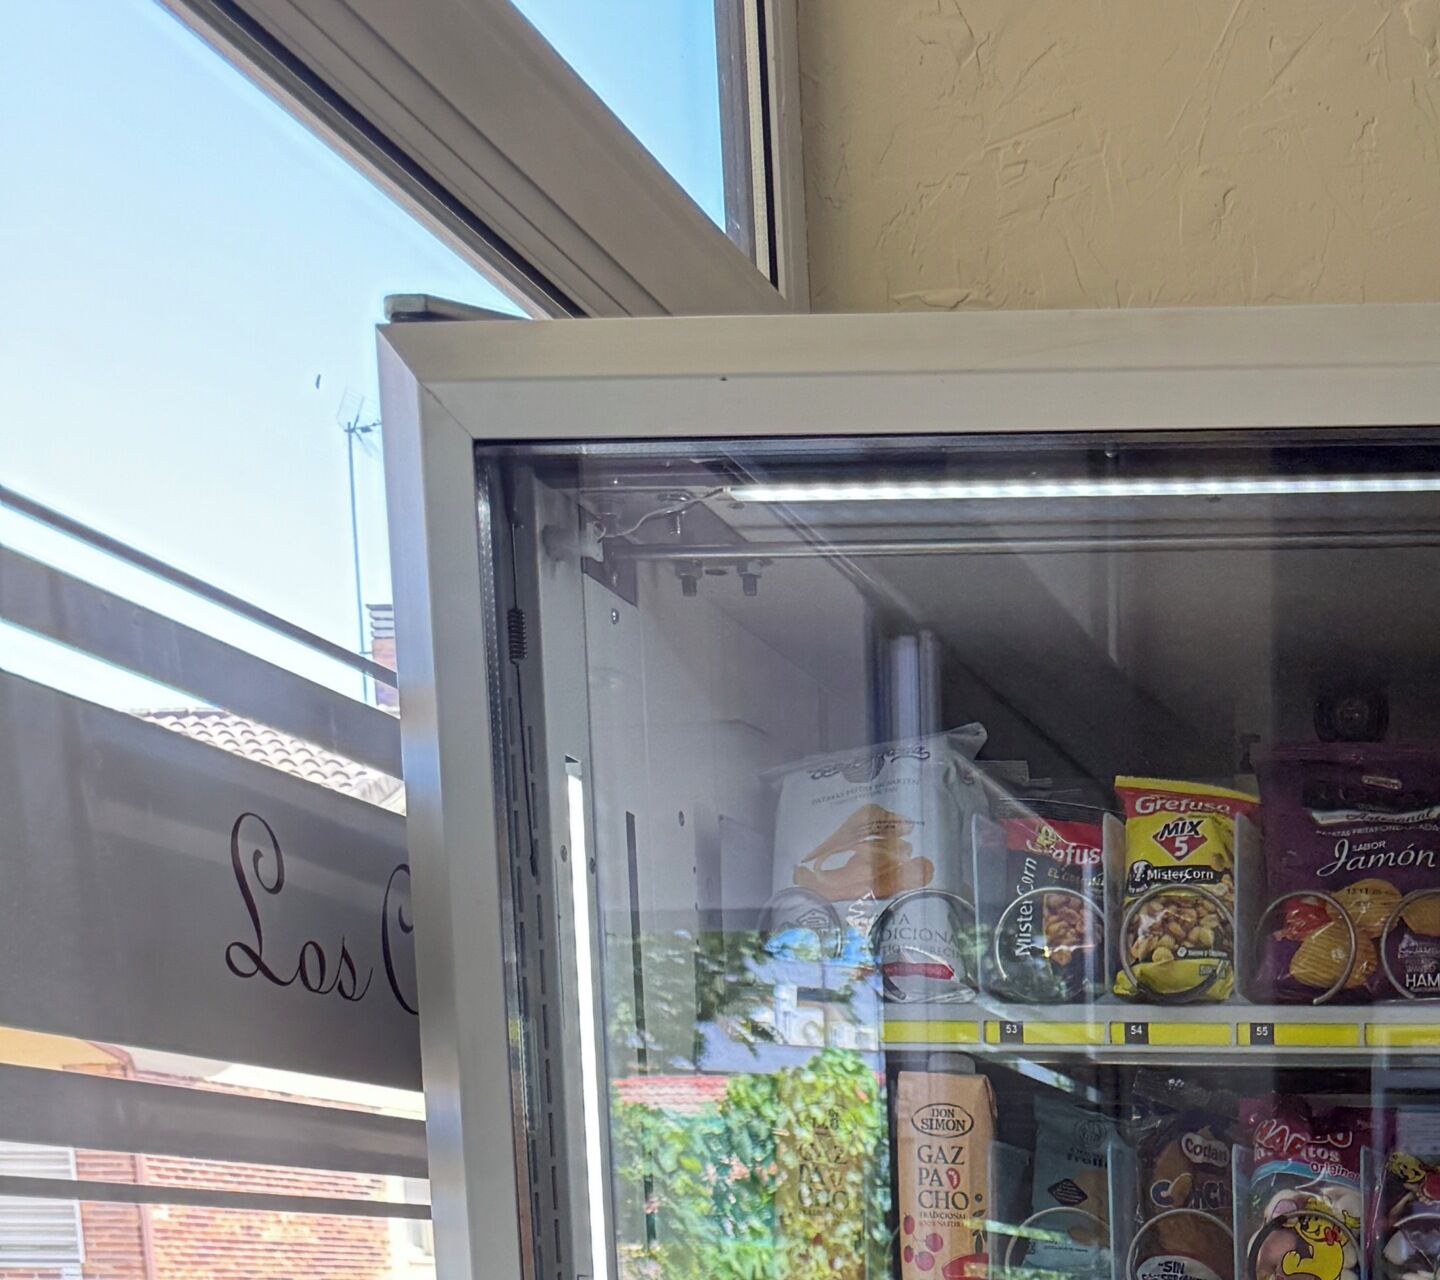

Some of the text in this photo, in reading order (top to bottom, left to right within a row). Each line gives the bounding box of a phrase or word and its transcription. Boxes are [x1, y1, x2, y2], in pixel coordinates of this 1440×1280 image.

[1135, 796, 1231, 814] Grefusa
[1159, 820, 1203, 840] MIX
[1174, 837, 1189, 856] 5
[1352, 840, 1386, 851] SABOR
[1317, 838, 1436, 876] Jamón
[225, 812, 373, 1001] Los
[1406, 973, 1440, 988] HAM
[1006, 1024, 1017, 1034] 53
[1130, 1025, 1143, 1035] 54
[1256, 1026, 1268, 1037] 55
[931, 1108, 955, 1118] DON
[921, 1119, 966, 1132] SIMON
[918, 1145, 965, 1165] GAZ
[918, 1168, 944, 1187] PA
[918, 1191, 969, 1211] CHO
